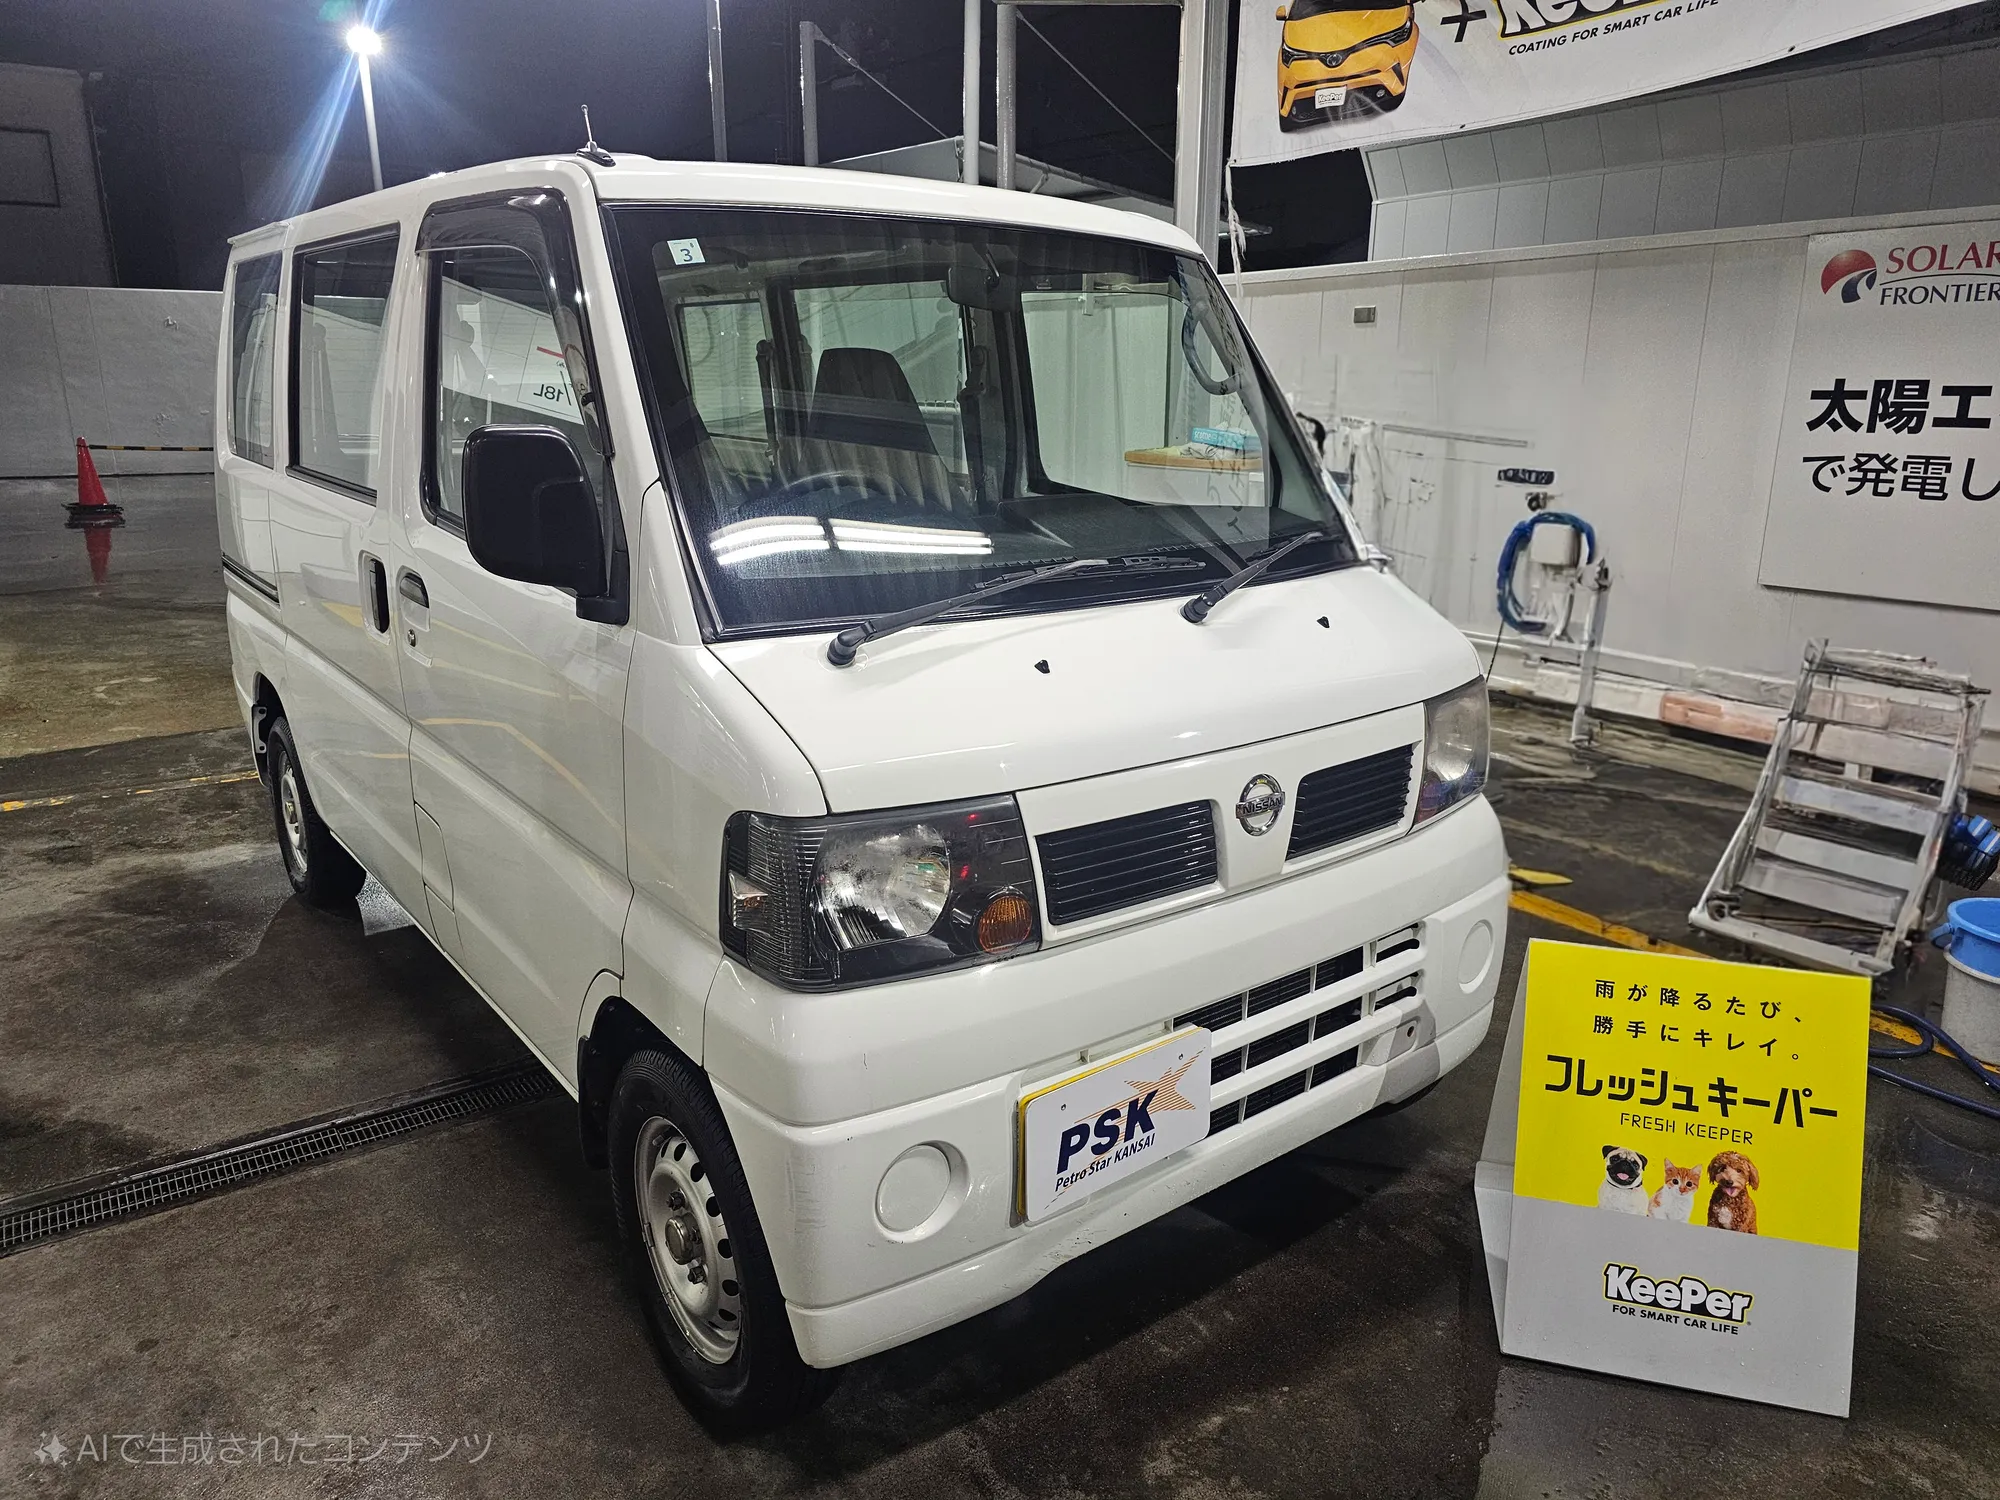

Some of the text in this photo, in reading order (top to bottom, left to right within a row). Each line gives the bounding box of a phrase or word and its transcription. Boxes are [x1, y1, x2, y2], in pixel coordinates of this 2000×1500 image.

[1508, 34, 1567, 56] COATING
[1571, 27, 1599, 43] FOR
[1602, 14, 1651, 35] SMART
[1653, 5, 1683, 22] CAR
[680, 248, 693, 262] 3
[1886, 241, 2000, 274] SOLAR
[1880, 282, 2000, 306] FRONTIER
[1805, 378, 1993, 435] 太陽エ
[1802, 453, 2000, 501] で発電し
[1242, 796, 1282, 814] NISSAN
[1595, 979, 1802, 1024] 雨が降るたび、
[1593, 1015, 1800, 1061] 勝手にキレイ。
[1545, 1053, 1839, 1129] フレッシュキーパー
[1056, 1088, 1160, 1175] PSK
[1620, 1112, 1754, 1146] FRESH KEEPER
[1055, 1132, 1156, 1192] Petro Star KANSAI
[1603, 1262, 1754, 1326] KeePer
[1612, 1304, 1739, 1336] FOR SMART CAR LIFE
